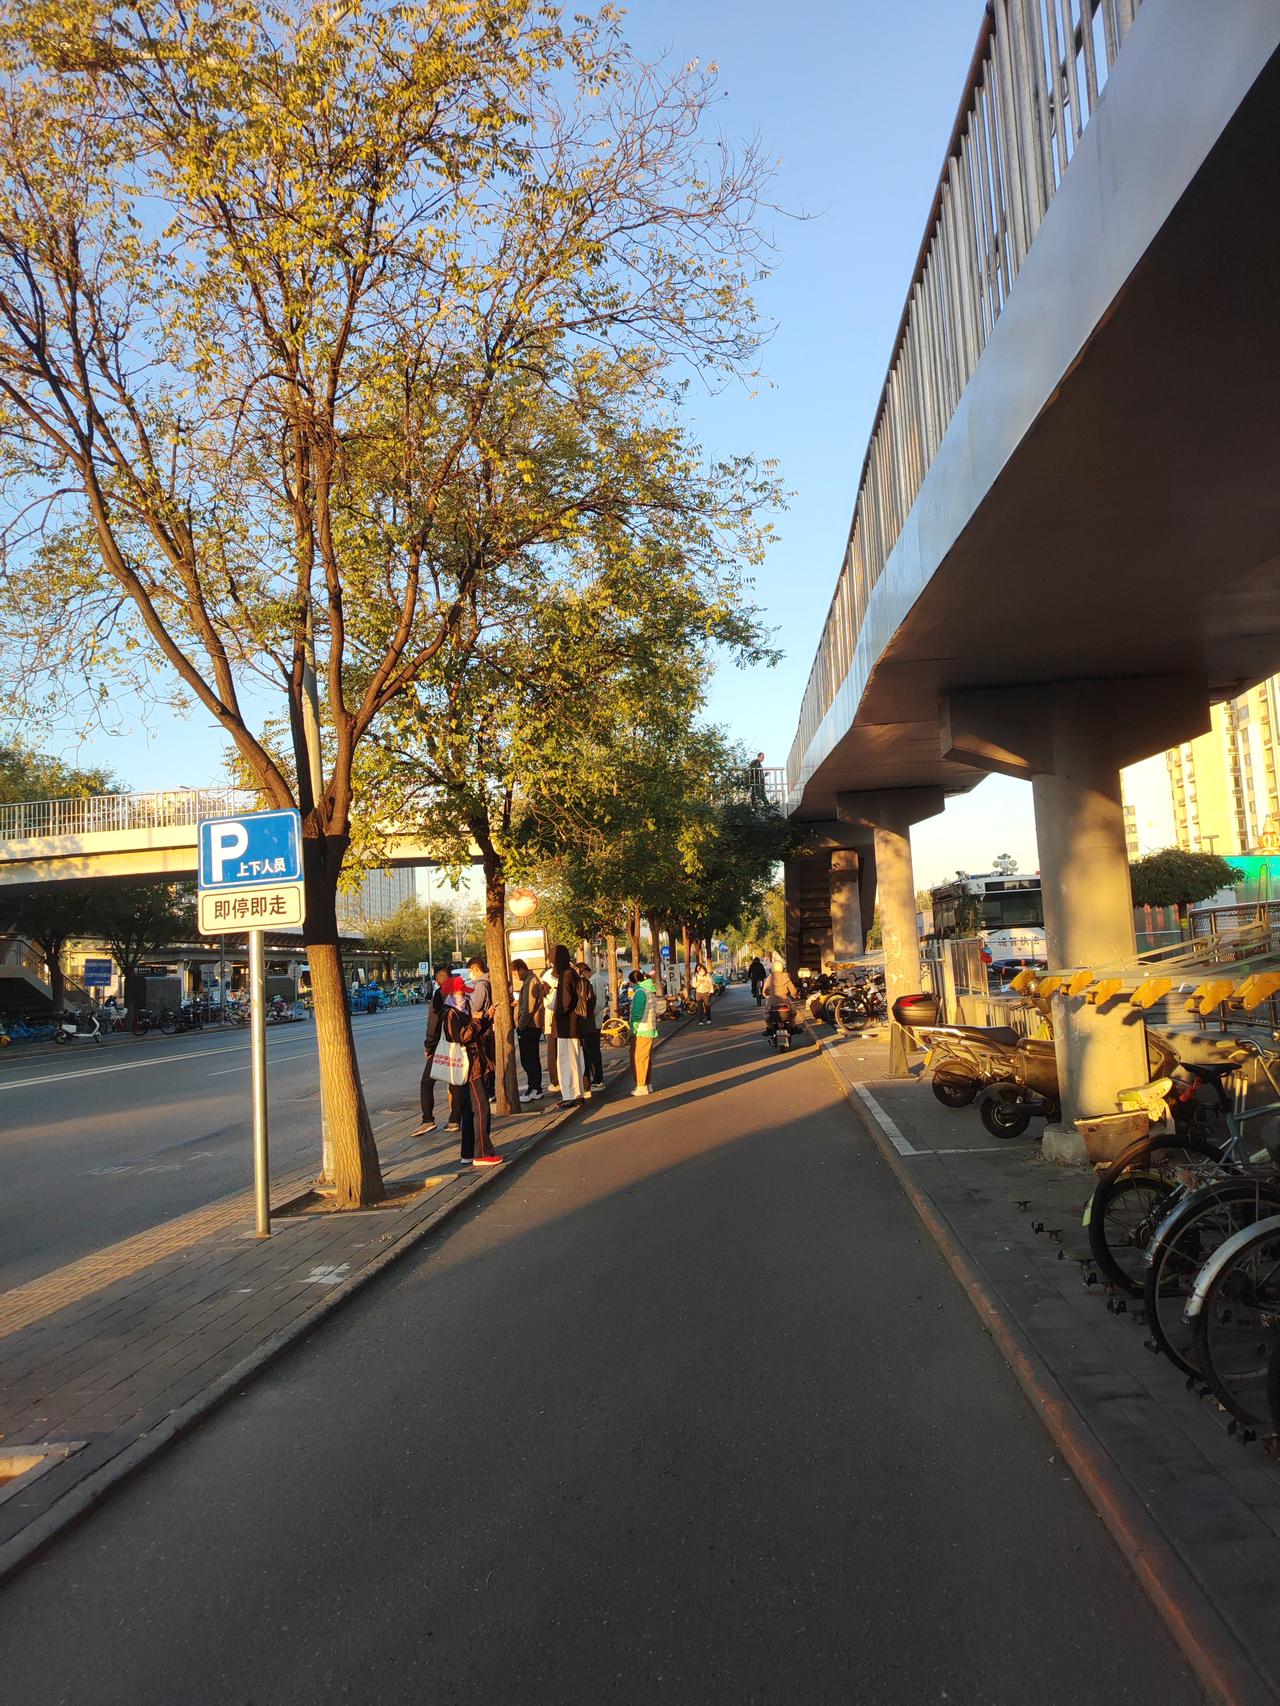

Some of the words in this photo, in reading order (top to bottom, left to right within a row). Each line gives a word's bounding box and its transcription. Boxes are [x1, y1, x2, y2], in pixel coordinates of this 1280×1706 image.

[211, 822, 249, 882] P
[236, 857, 287, 877] 上下人员
[214, 894, 287, 920] 即停即走
